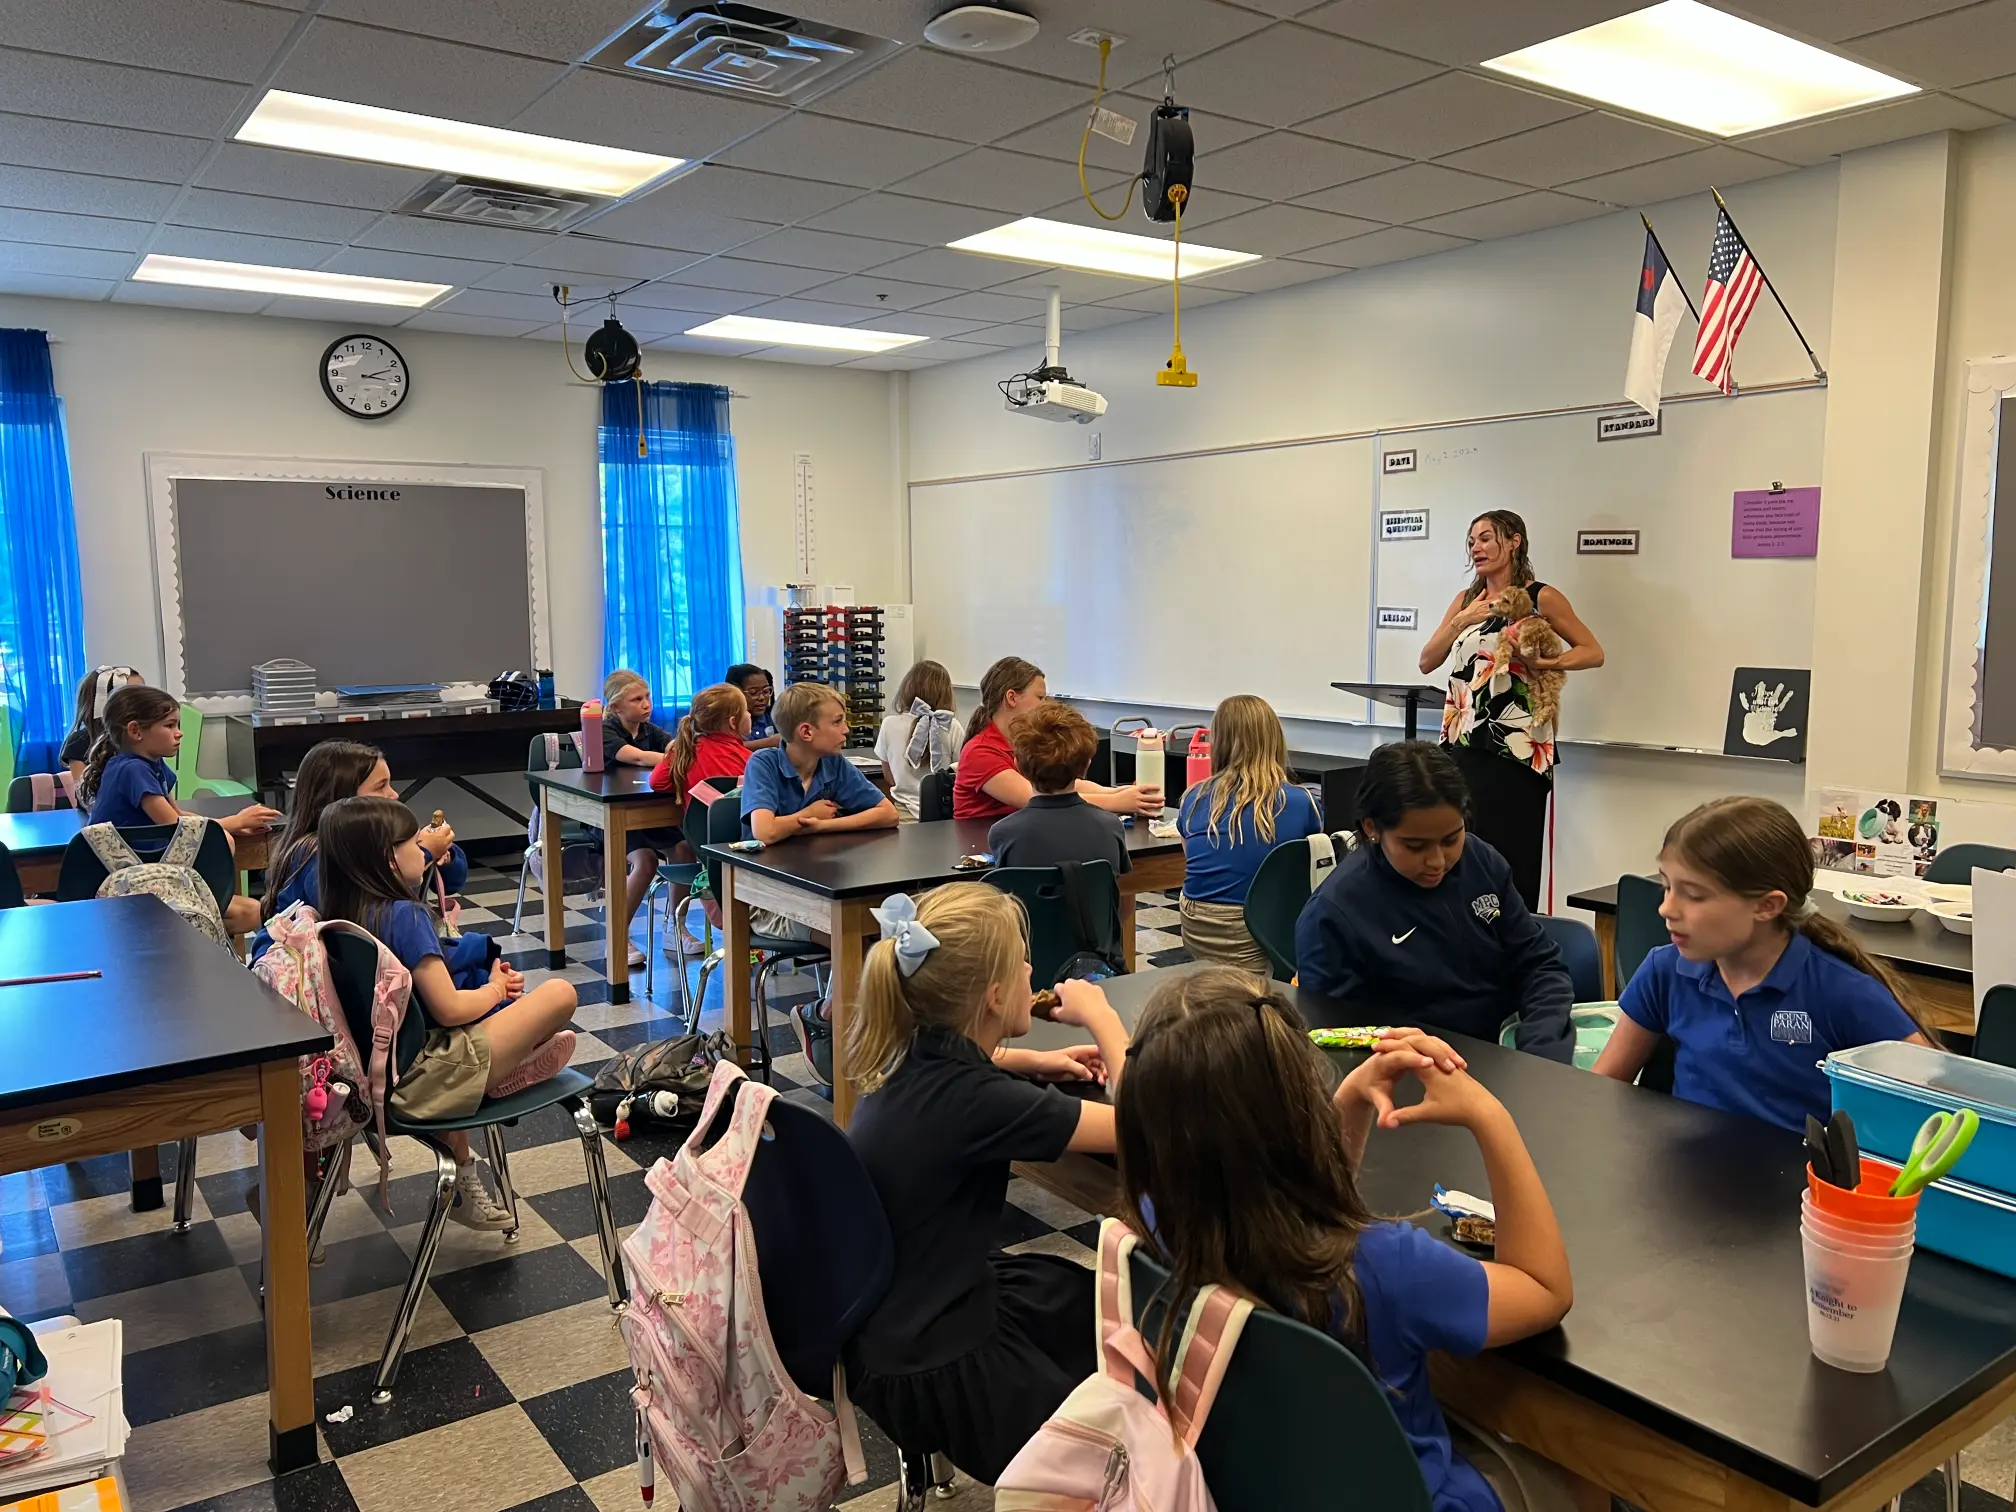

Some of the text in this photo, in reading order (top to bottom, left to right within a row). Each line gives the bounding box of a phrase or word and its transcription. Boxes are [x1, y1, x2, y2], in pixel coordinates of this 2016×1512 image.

[361, 342, 372, 350] 12
[333, 354, 344, 362] 10
[394, 375, 401, 383] 3
[349, 397, 355, 405] 7
[380, 400, 387, 408] 5
[1603, 418, 1655, 433] STANDARD
[1389, 457, 1411, 467] DATE
[325, 485, 401, 501] Science
[1386, 516, 1423, 525] ESSENTIAL
[1386, 525, 1423, 534] QUESTION
[1582, 538, 1633, 546] HOMEWORK
[1382, 614, 1412, 622] LESSON
[1471, 893, 1500, 916] MPC
[1774, 1012, 1808, 1022] MOUNT
[1773, 1019, 1809, 1030] PARAN
[1815, 1290, 1844, 1308] Knight
[1847, 1303, 1857, 1311] to
[1811, 1295, 1854, 1319] Remember
